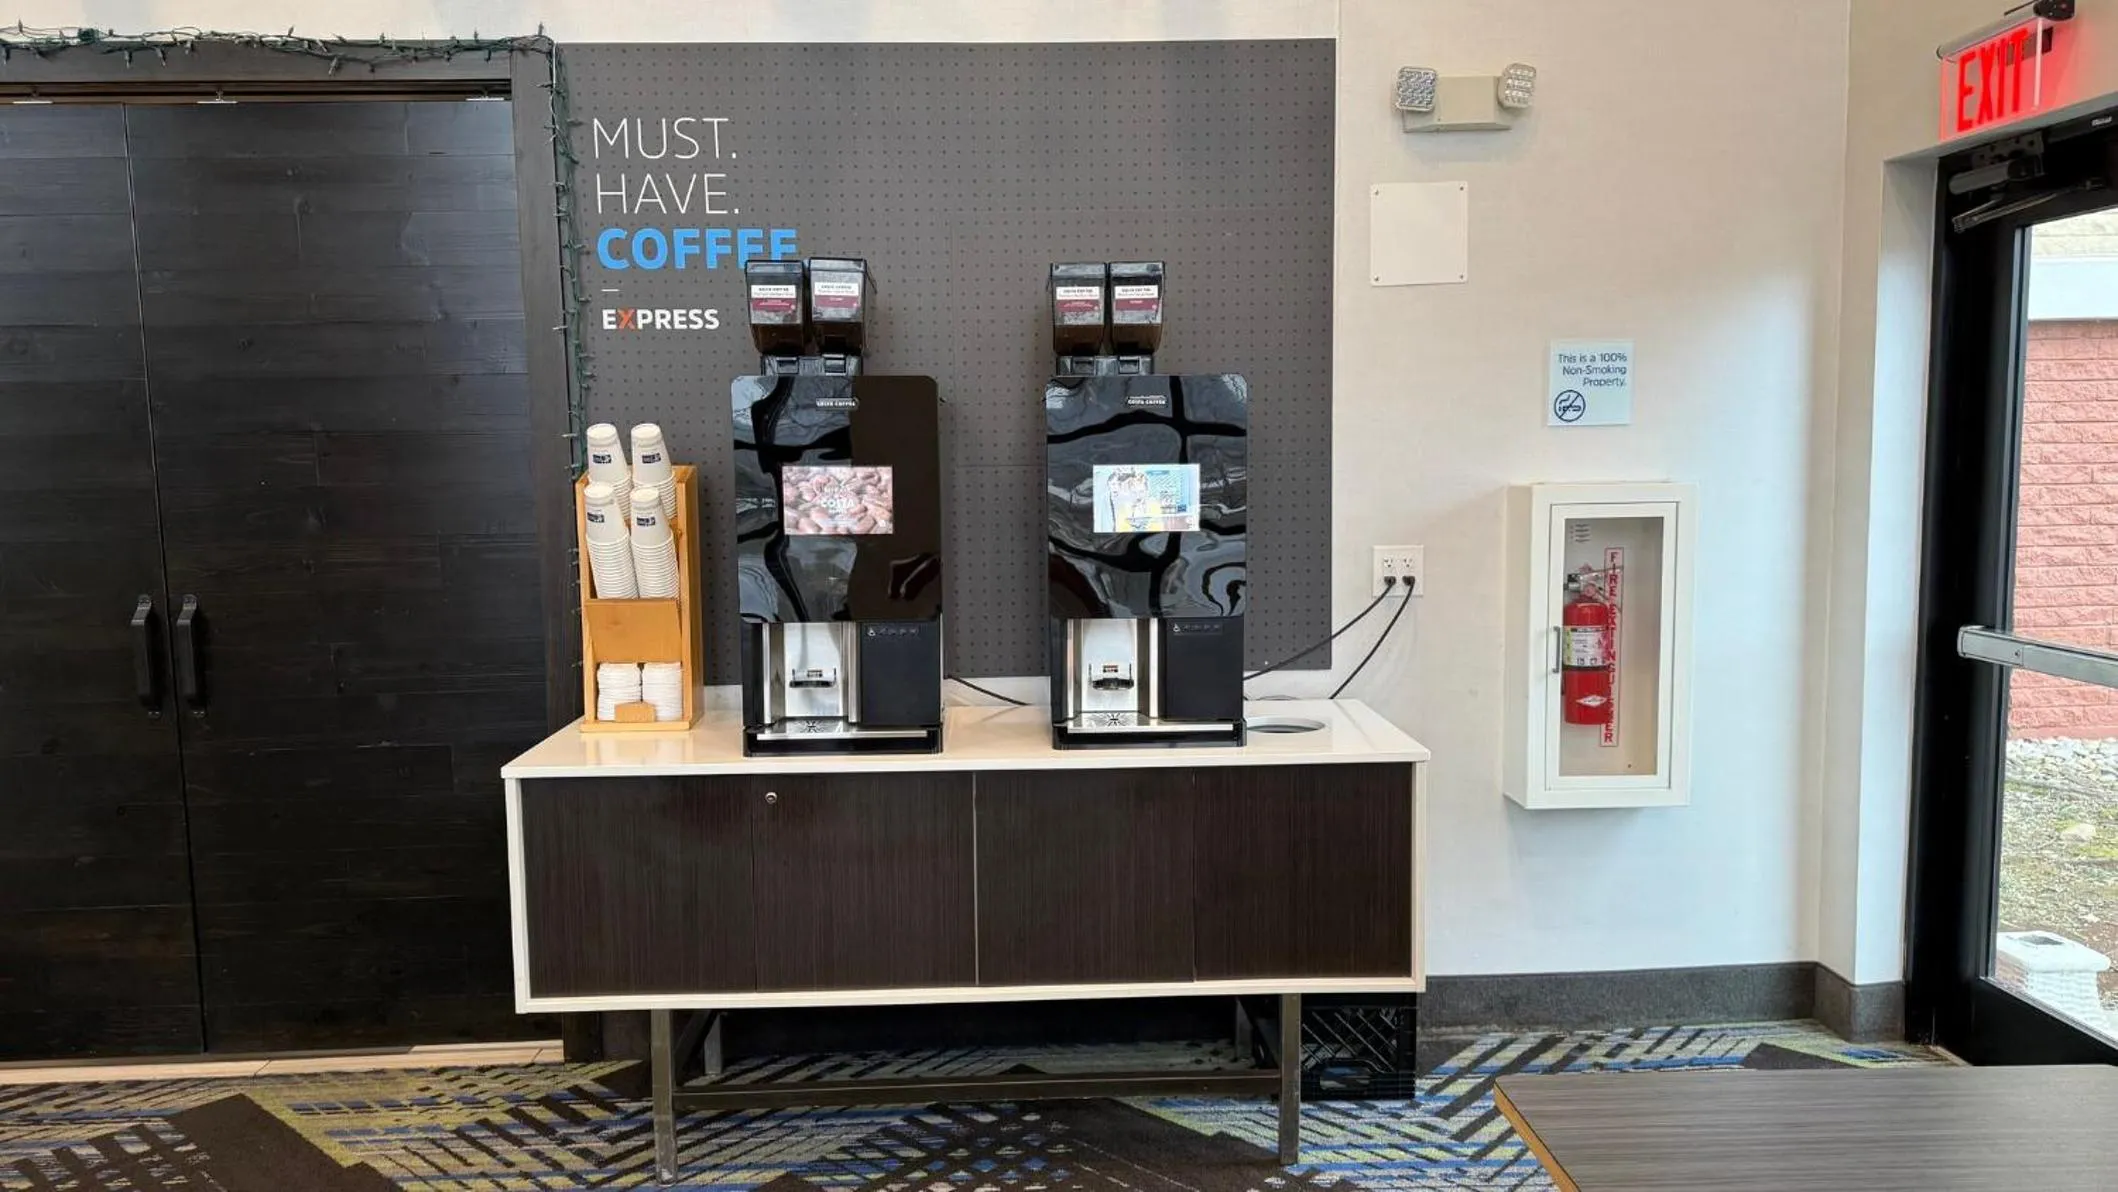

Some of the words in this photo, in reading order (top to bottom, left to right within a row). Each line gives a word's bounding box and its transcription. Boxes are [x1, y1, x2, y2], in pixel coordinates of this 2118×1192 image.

[1957, 28, 2028, 132] EXIT
[593, 117, 737, 160] MUST.
[596, 173, 739, 214] HAVE.
[602, 308, 720, 330] EXPRESS
[1559, 353, 1577, 363] This
[1580, 353, 1588, 362] is
[1590, 354, 1597, 362] a
[1601, 352, 1628, 362] 100%
[1563, 365, 1628, 375] Non-Smoking
[1608, 551, 1619, 597] FIRE
[1604, 604, 1618, 742] EXTINGUISHER
